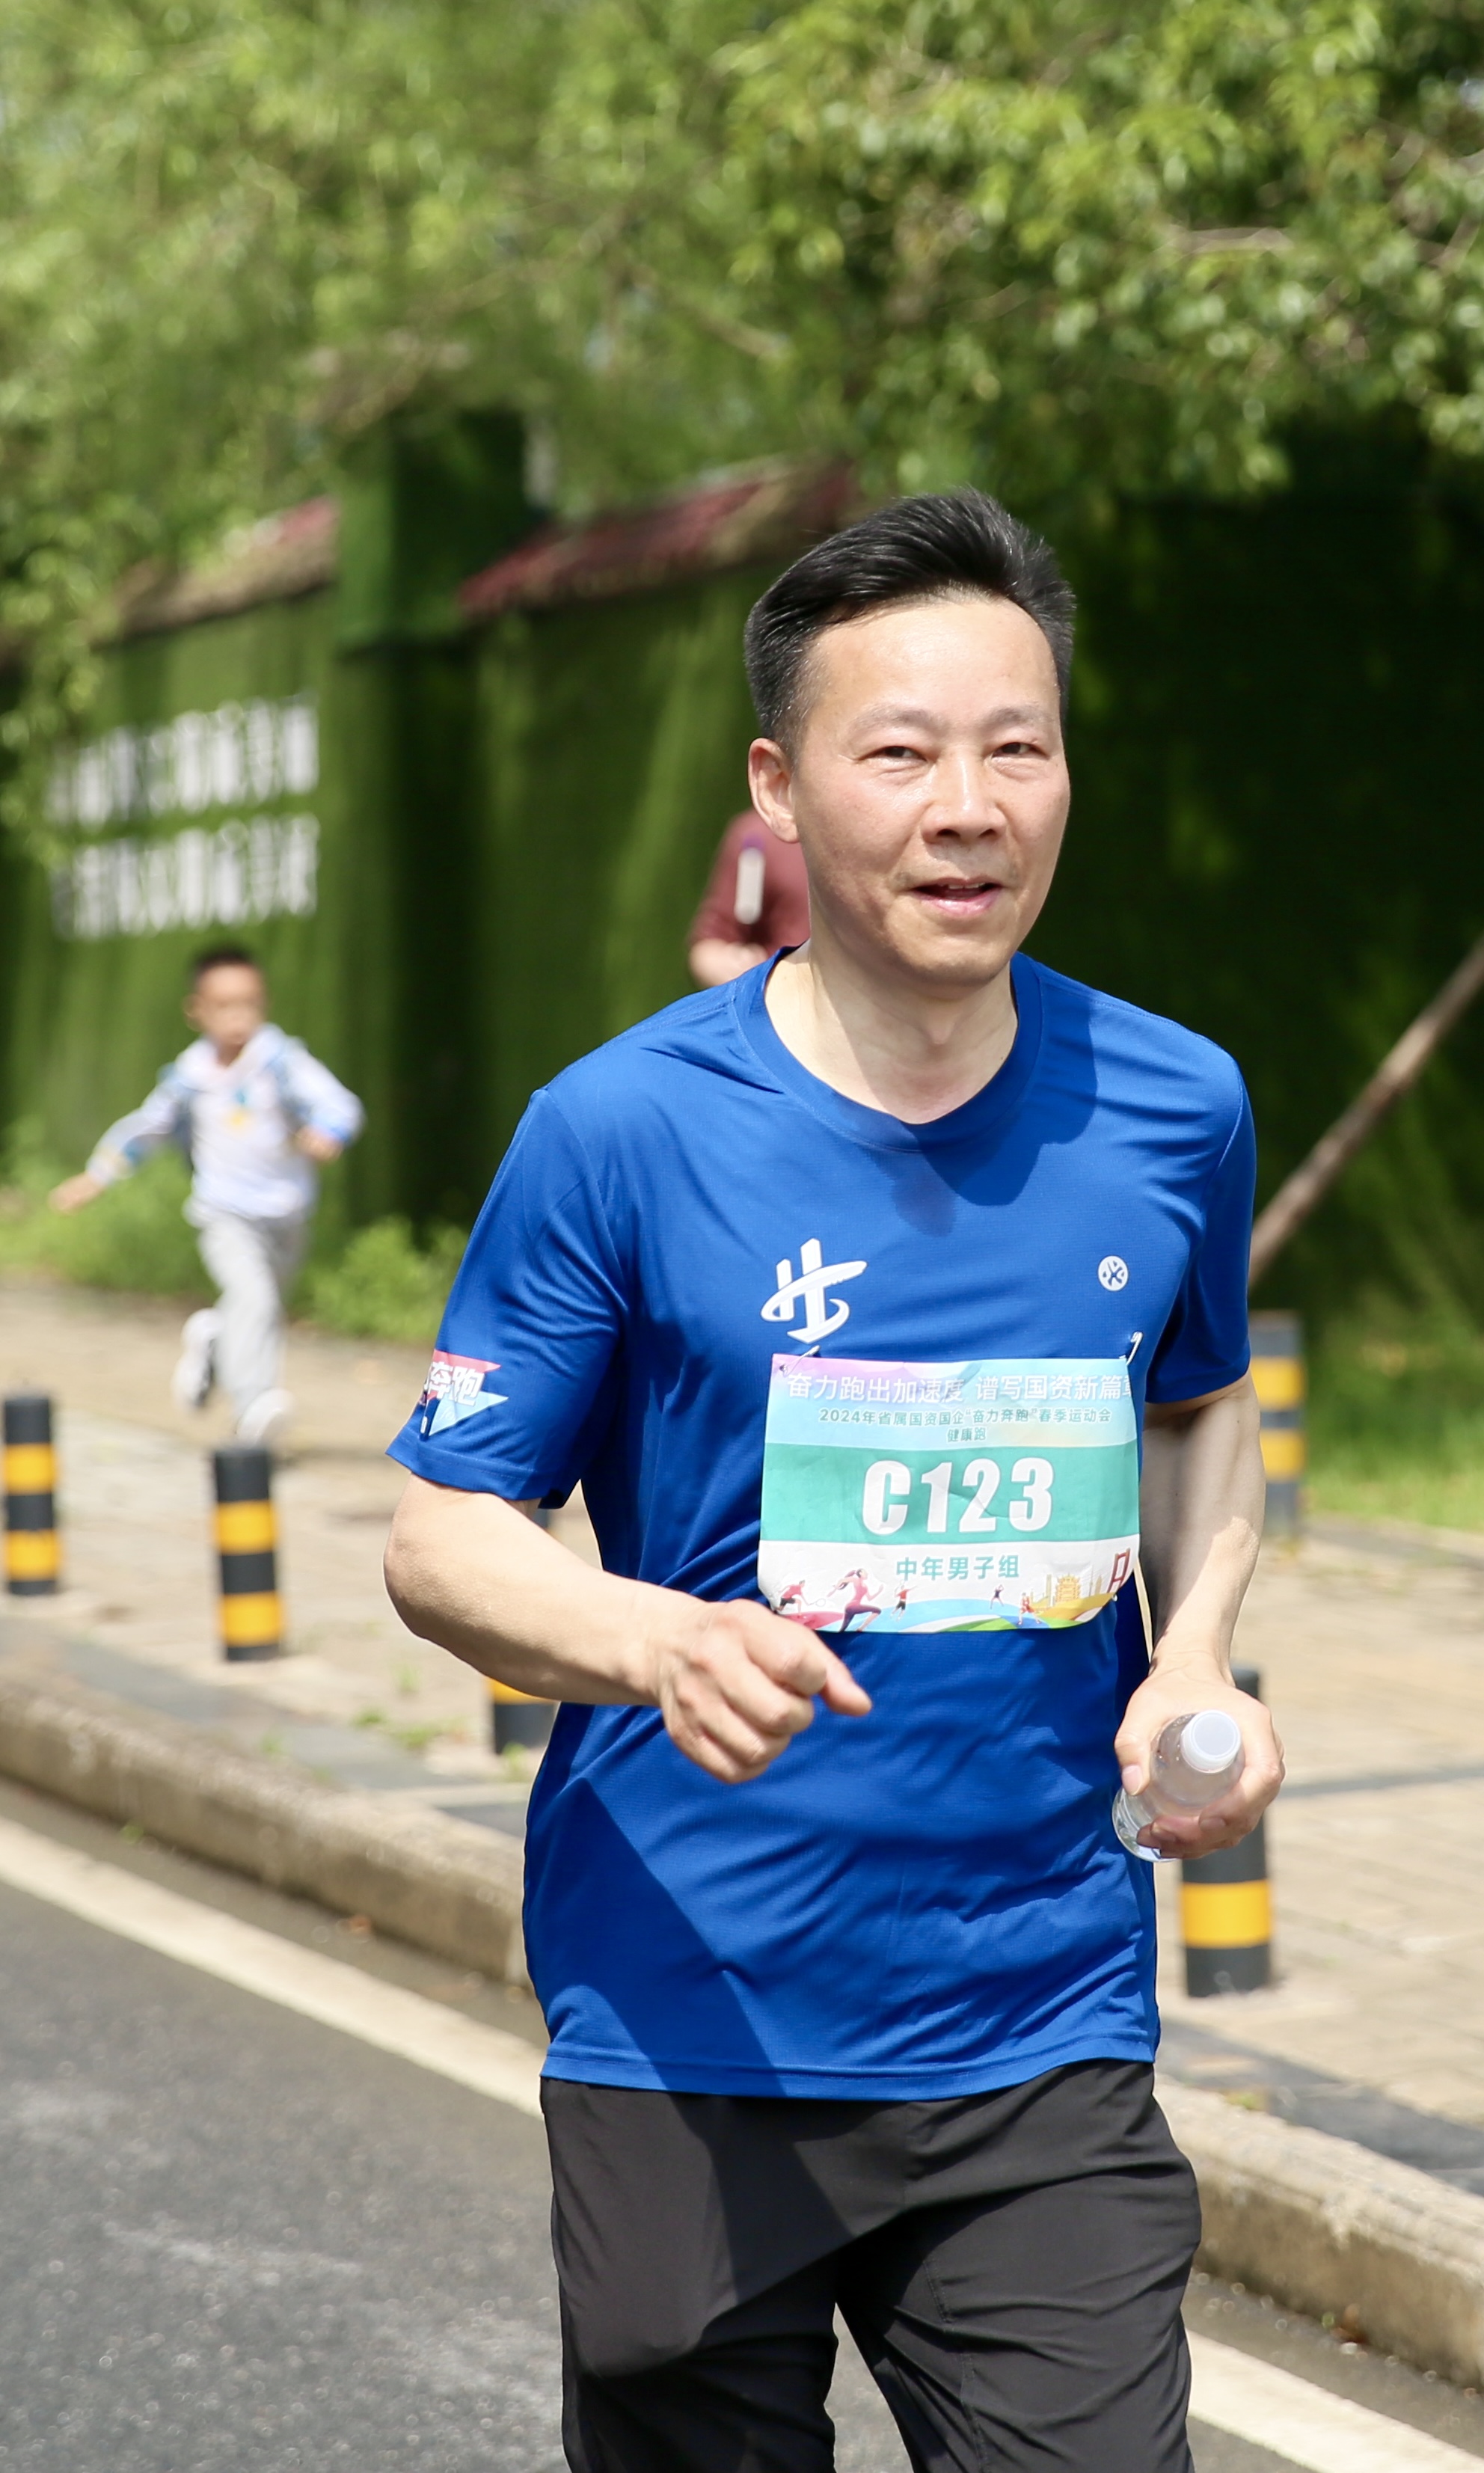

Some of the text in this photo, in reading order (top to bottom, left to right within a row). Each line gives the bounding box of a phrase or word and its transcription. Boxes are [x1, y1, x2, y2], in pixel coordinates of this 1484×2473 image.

[787, 1373, 964, 1403] 奋力跑出加速度
[947, 1427, 987, 1443] 健康跑
[862, 1457, 1055, 1536] C123
[895, 1554, 1020, 1581] 中年男子组
